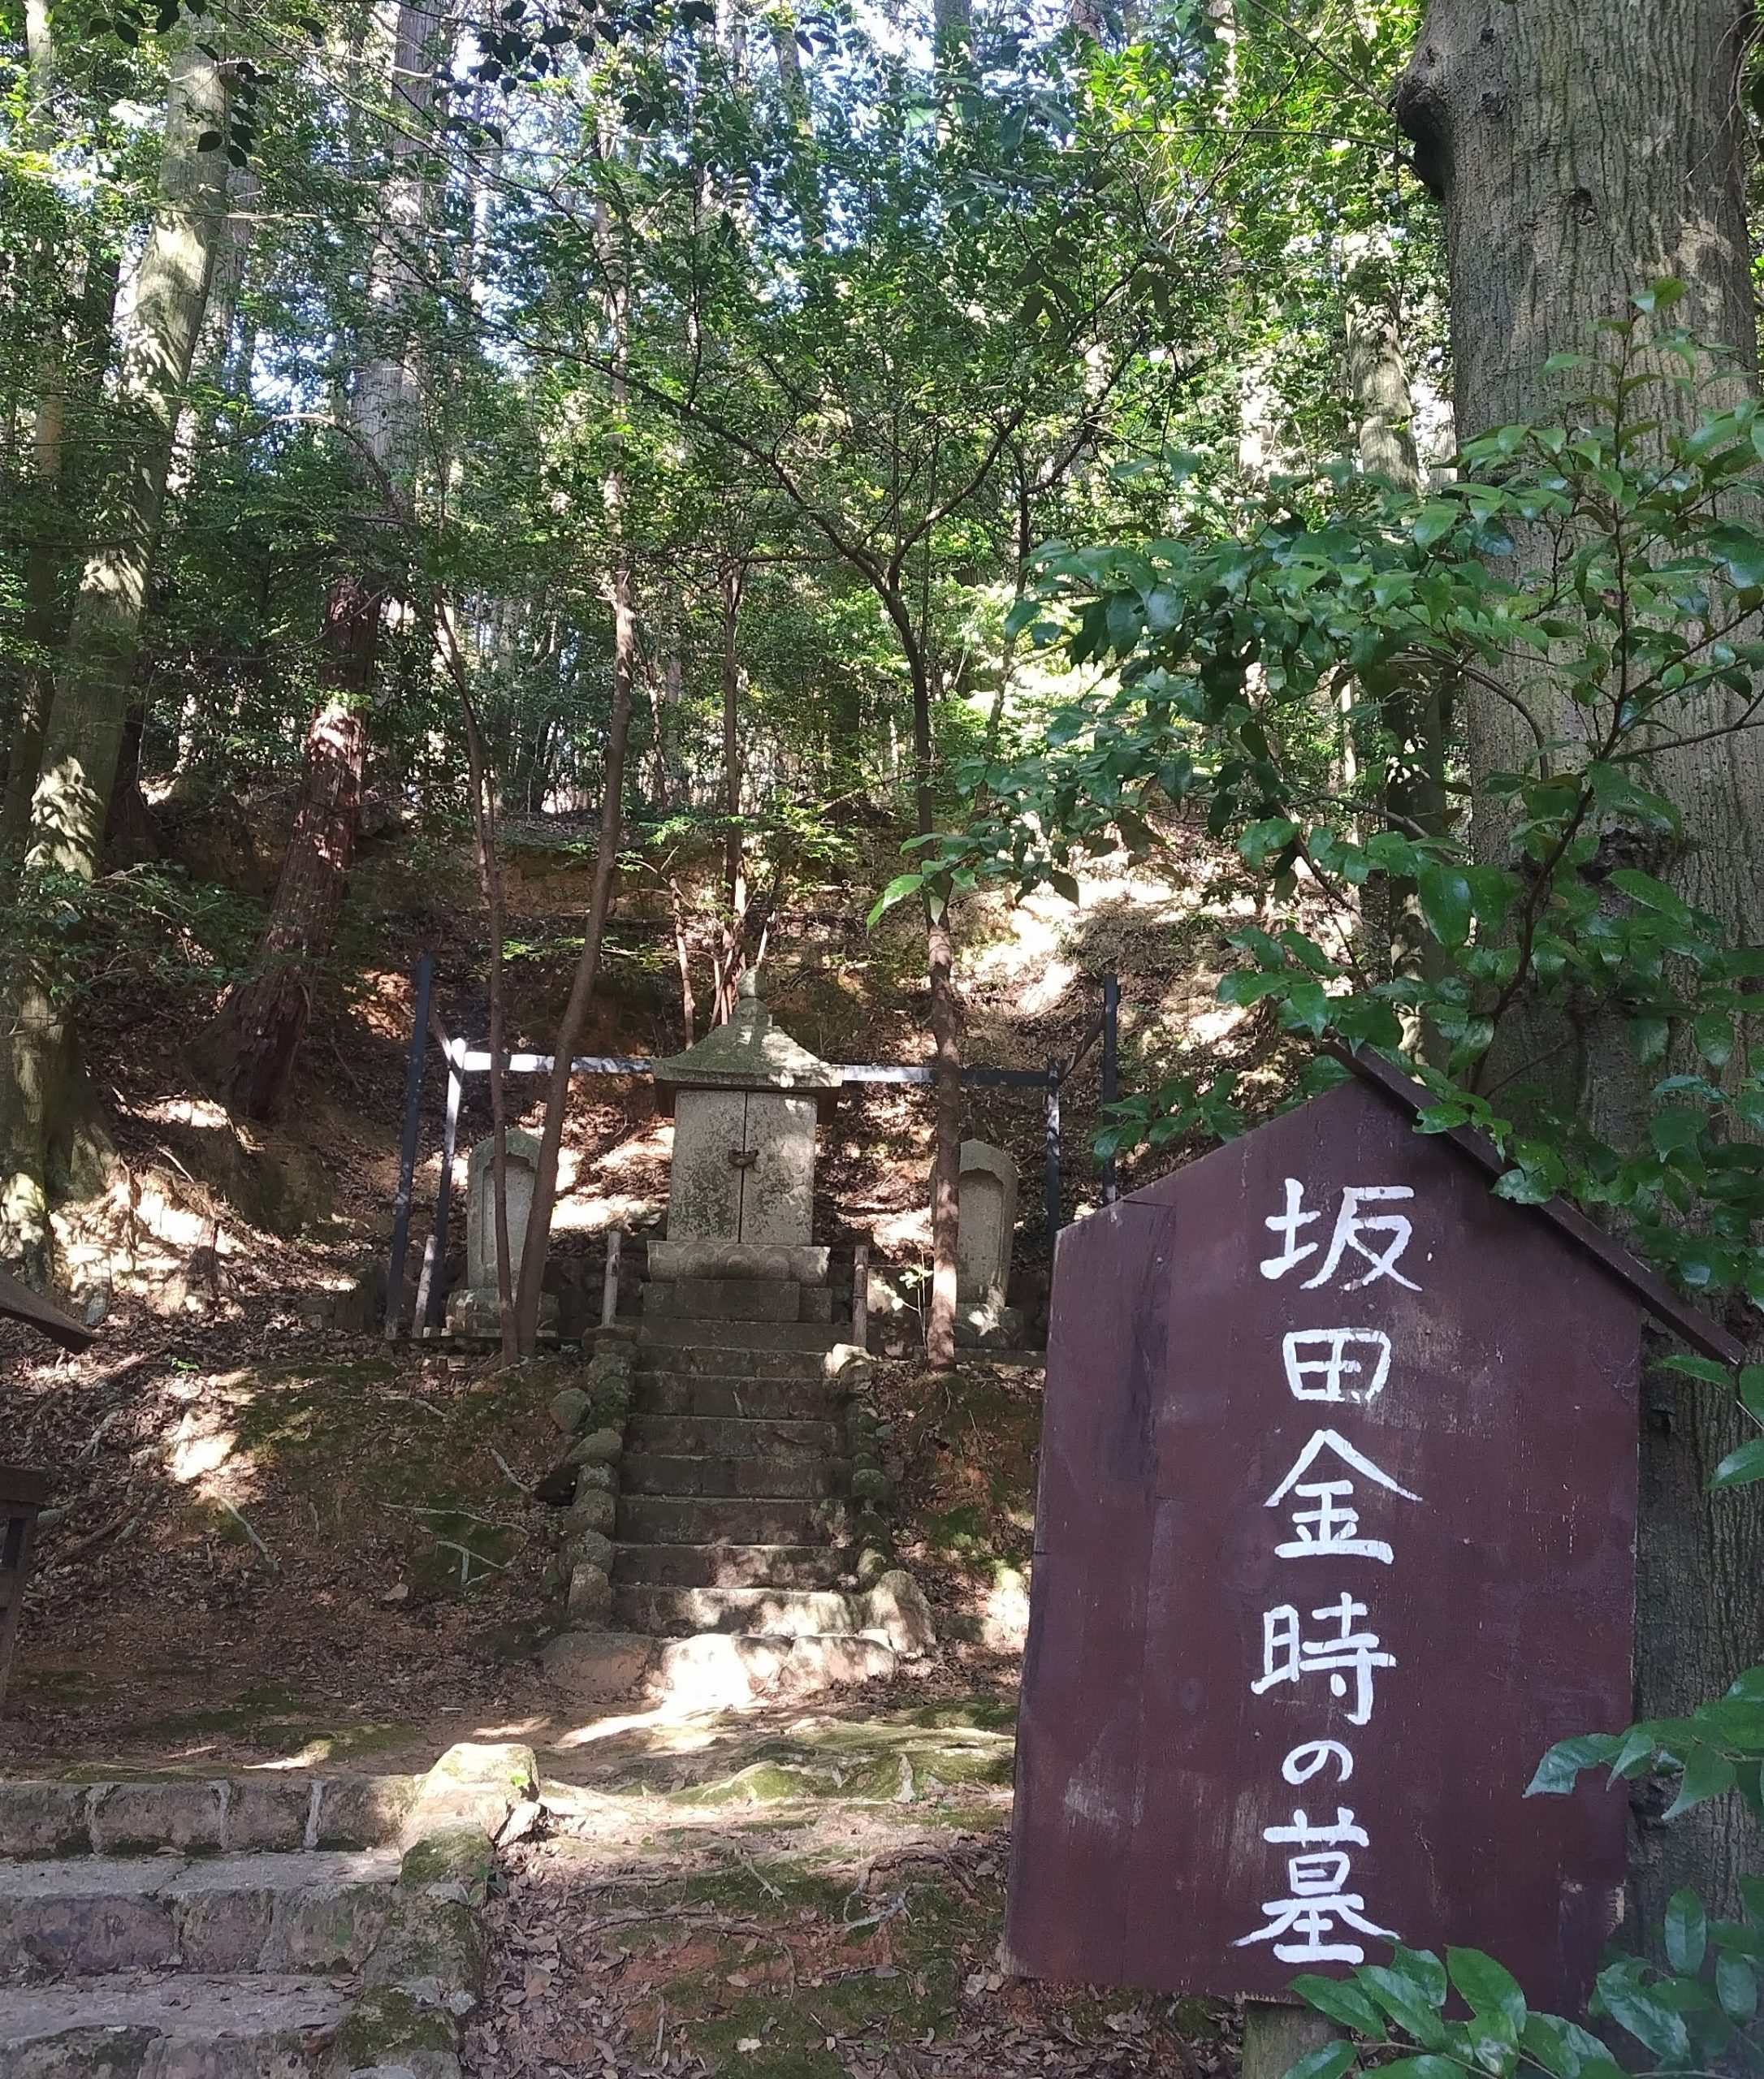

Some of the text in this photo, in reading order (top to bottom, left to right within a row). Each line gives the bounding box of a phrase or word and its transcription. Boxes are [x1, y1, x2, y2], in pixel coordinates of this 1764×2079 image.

[1234, 1177, 1423, 1965] 坂田金時の墓
